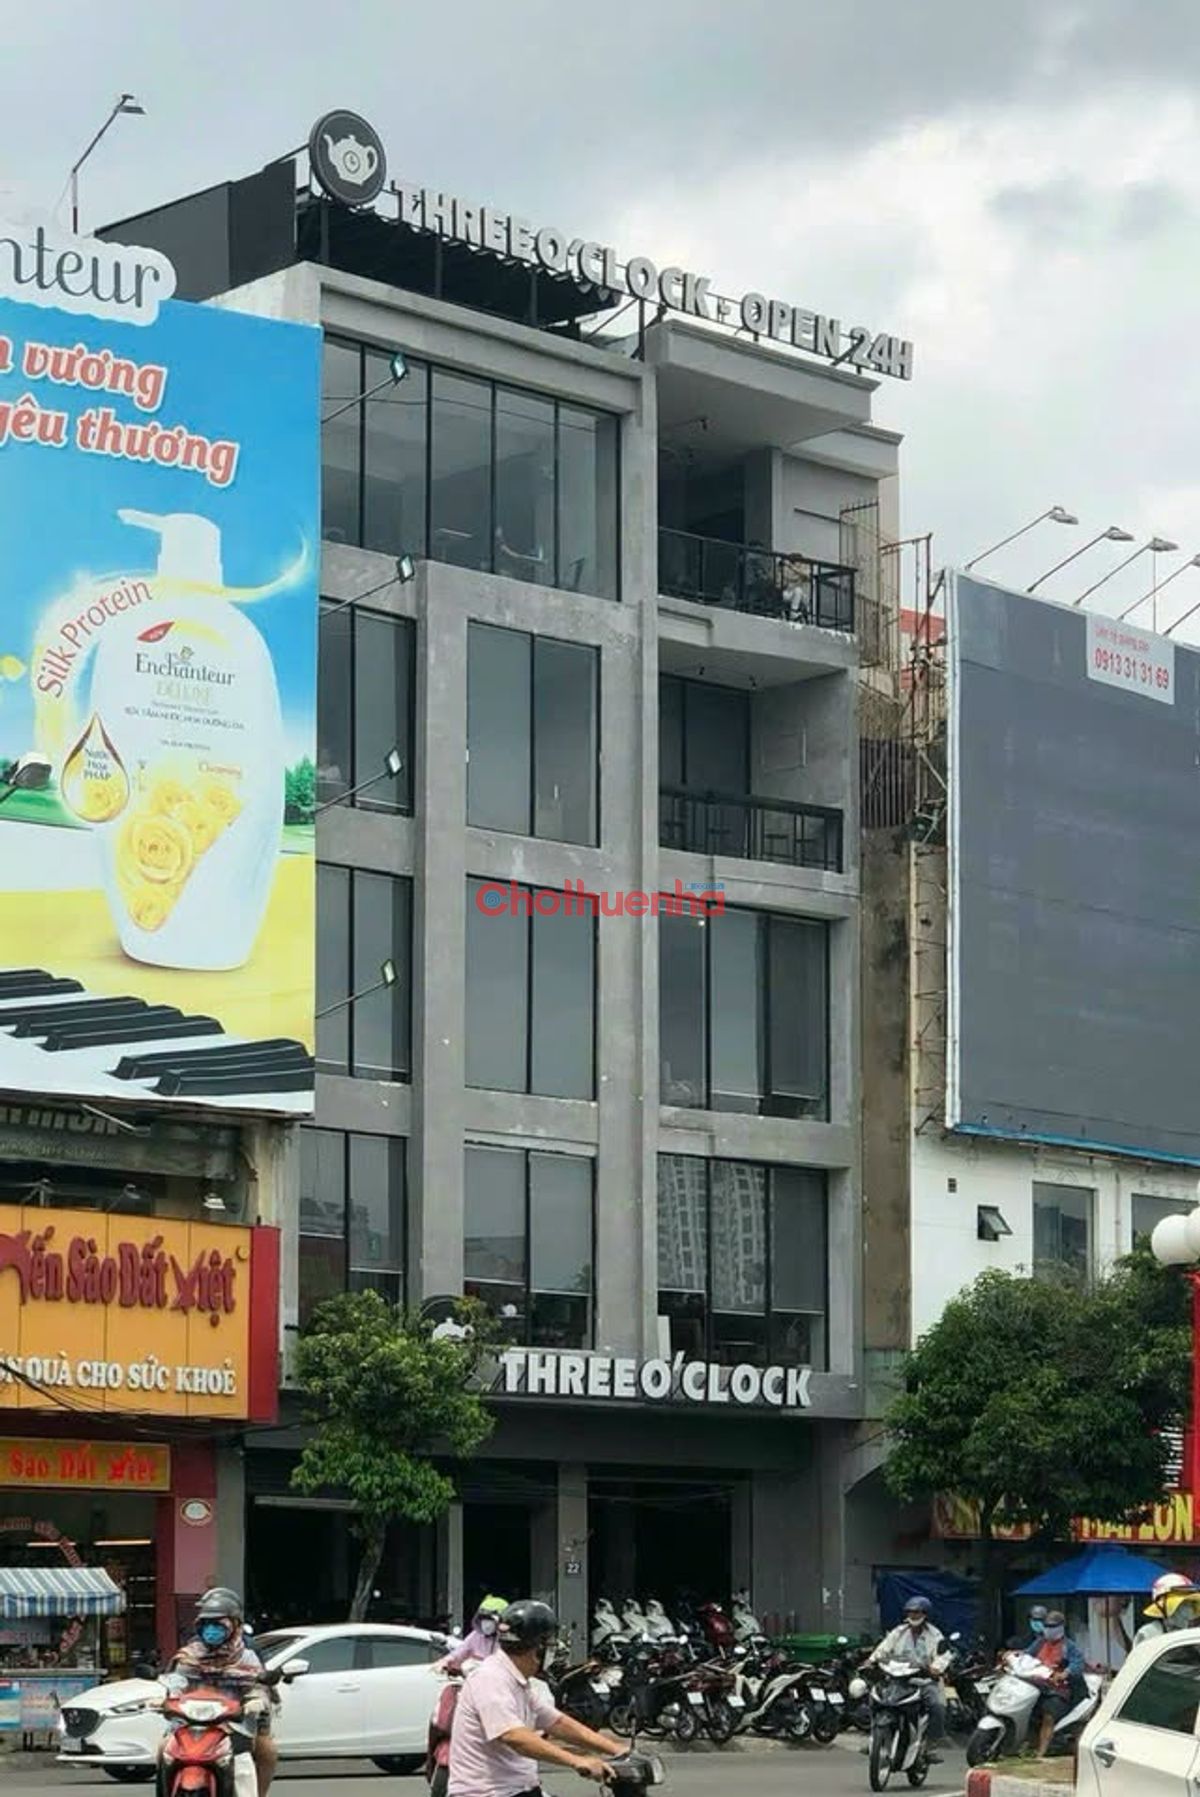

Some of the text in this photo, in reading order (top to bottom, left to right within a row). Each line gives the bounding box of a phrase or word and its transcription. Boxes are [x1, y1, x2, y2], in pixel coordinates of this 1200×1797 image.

[391, 177, 538, 262] THREE
[536, 226, 711, 318] O'CLOCK
[742, 292, 840, 357] OPEN
[851, 326, 913, 380] 24H
[25, 342, 165, 409] vương
[79, 410, 237, 484] thương
[37, 580, 152, 698] Silk Protein
[135, 652, 235, 686] Enchanteur
[66, 1236, 117, 1304] Sào
[170, 1250, 236, 1328] Việt
[26, 1350, 74, 1386] QUÀ
[77, 1360, 122, 1389] CHO
[128, 1355, 169, 1391] SỨC
[500, 1350, 812, 1406] THREE O'CLOCK
